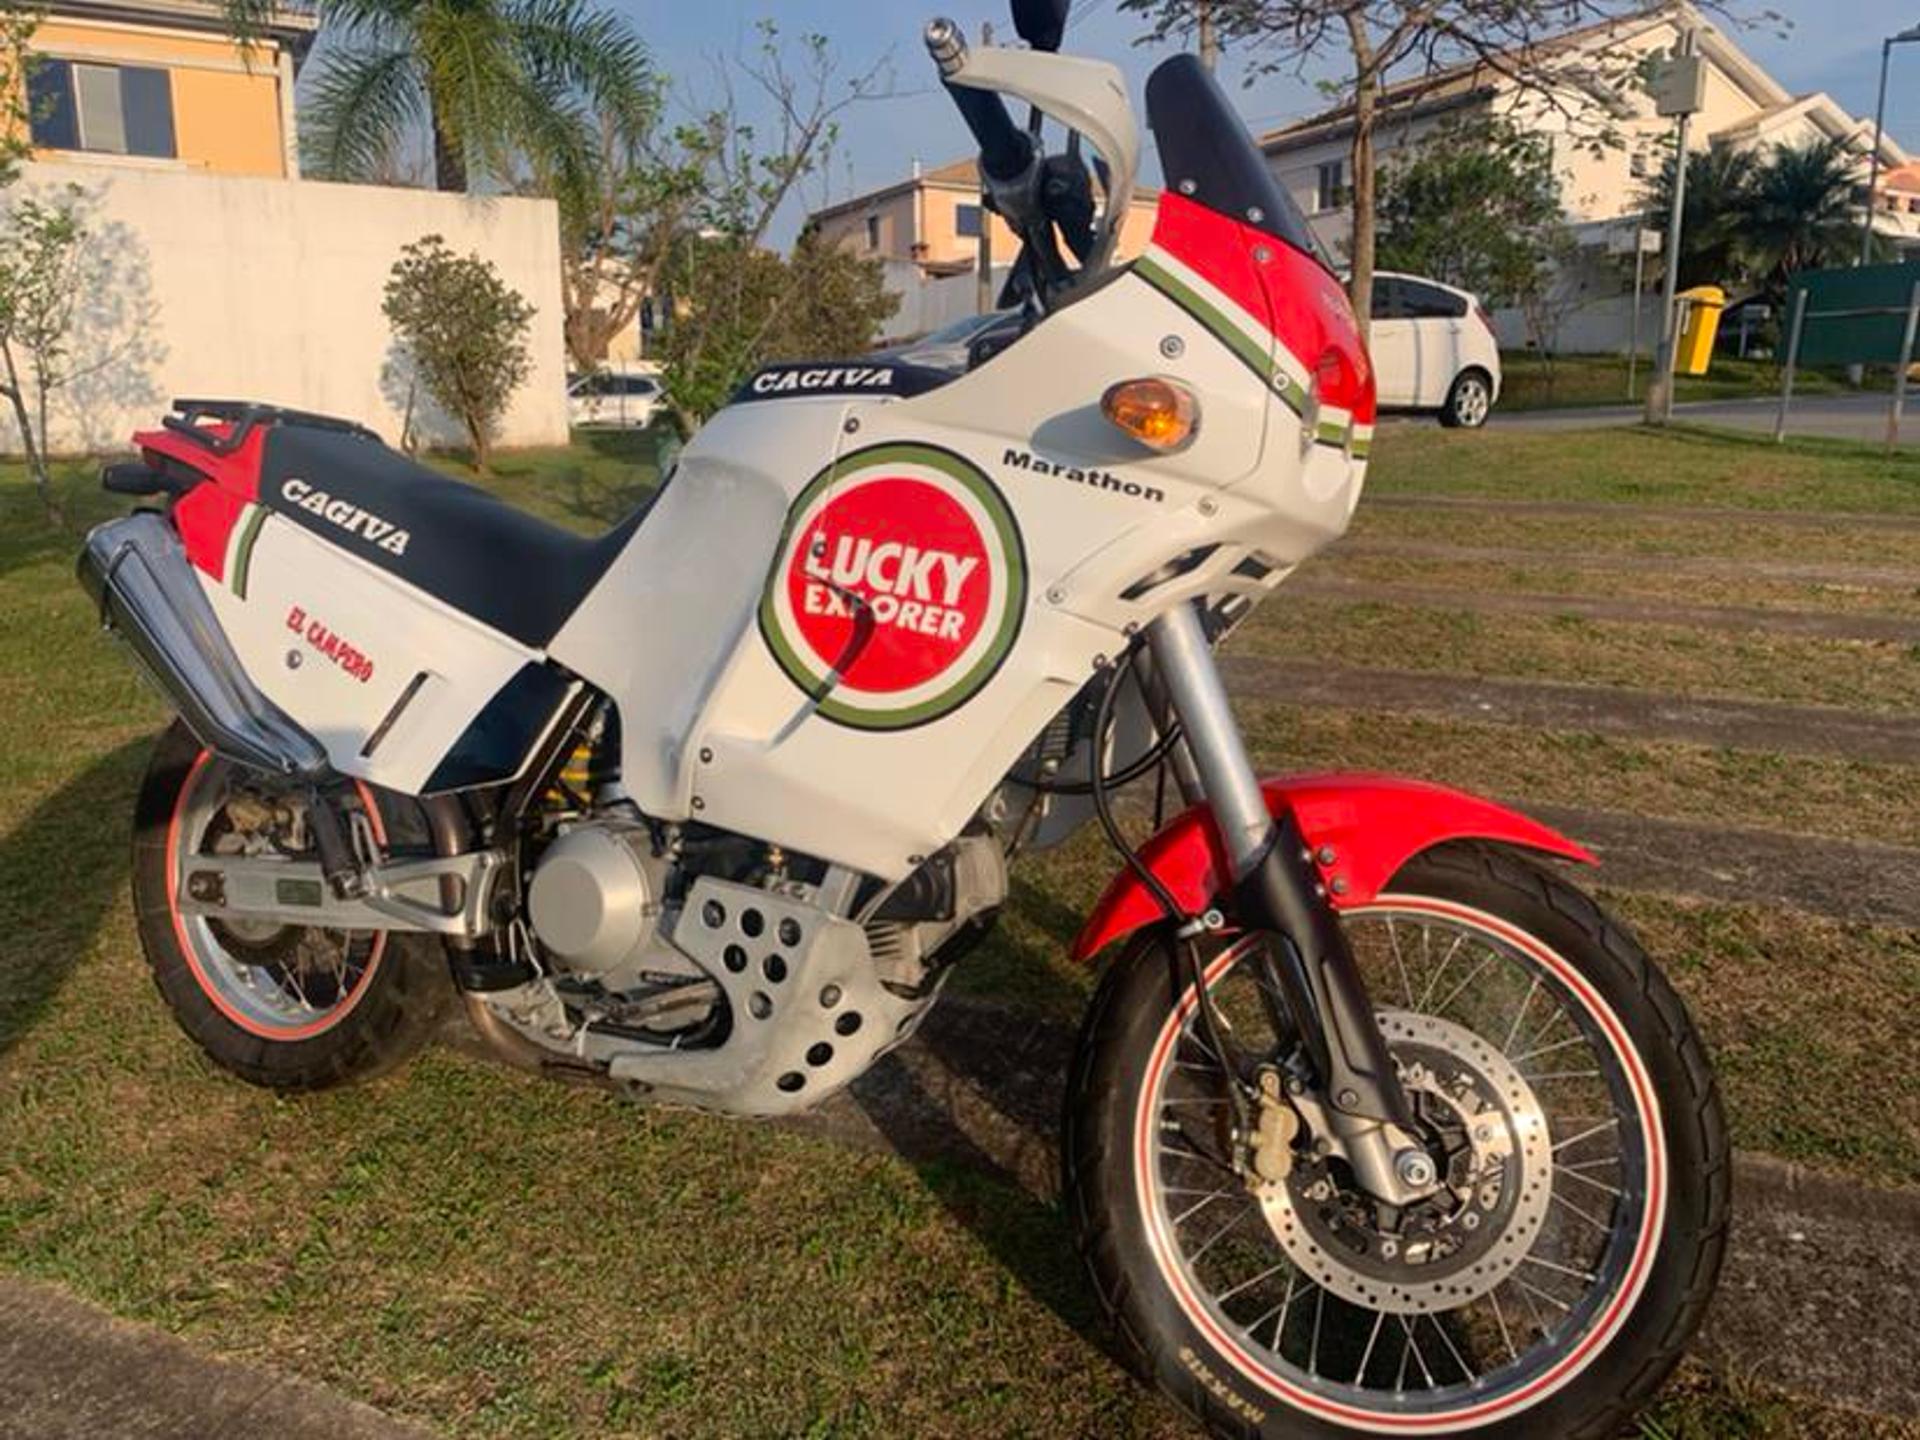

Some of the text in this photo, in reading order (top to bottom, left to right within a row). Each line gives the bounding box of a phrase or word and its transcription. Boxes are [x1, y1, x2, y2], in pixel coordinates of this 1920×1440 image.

[753, 367, 894, 393] CAGIVA
[1003, 449, 1165, 502] Marathon
[281, 478, 411, 555] CAGIVA
[804, 531, 978, 606] LUCKY
[287, 606, 373, 683] EL CAMPERO
